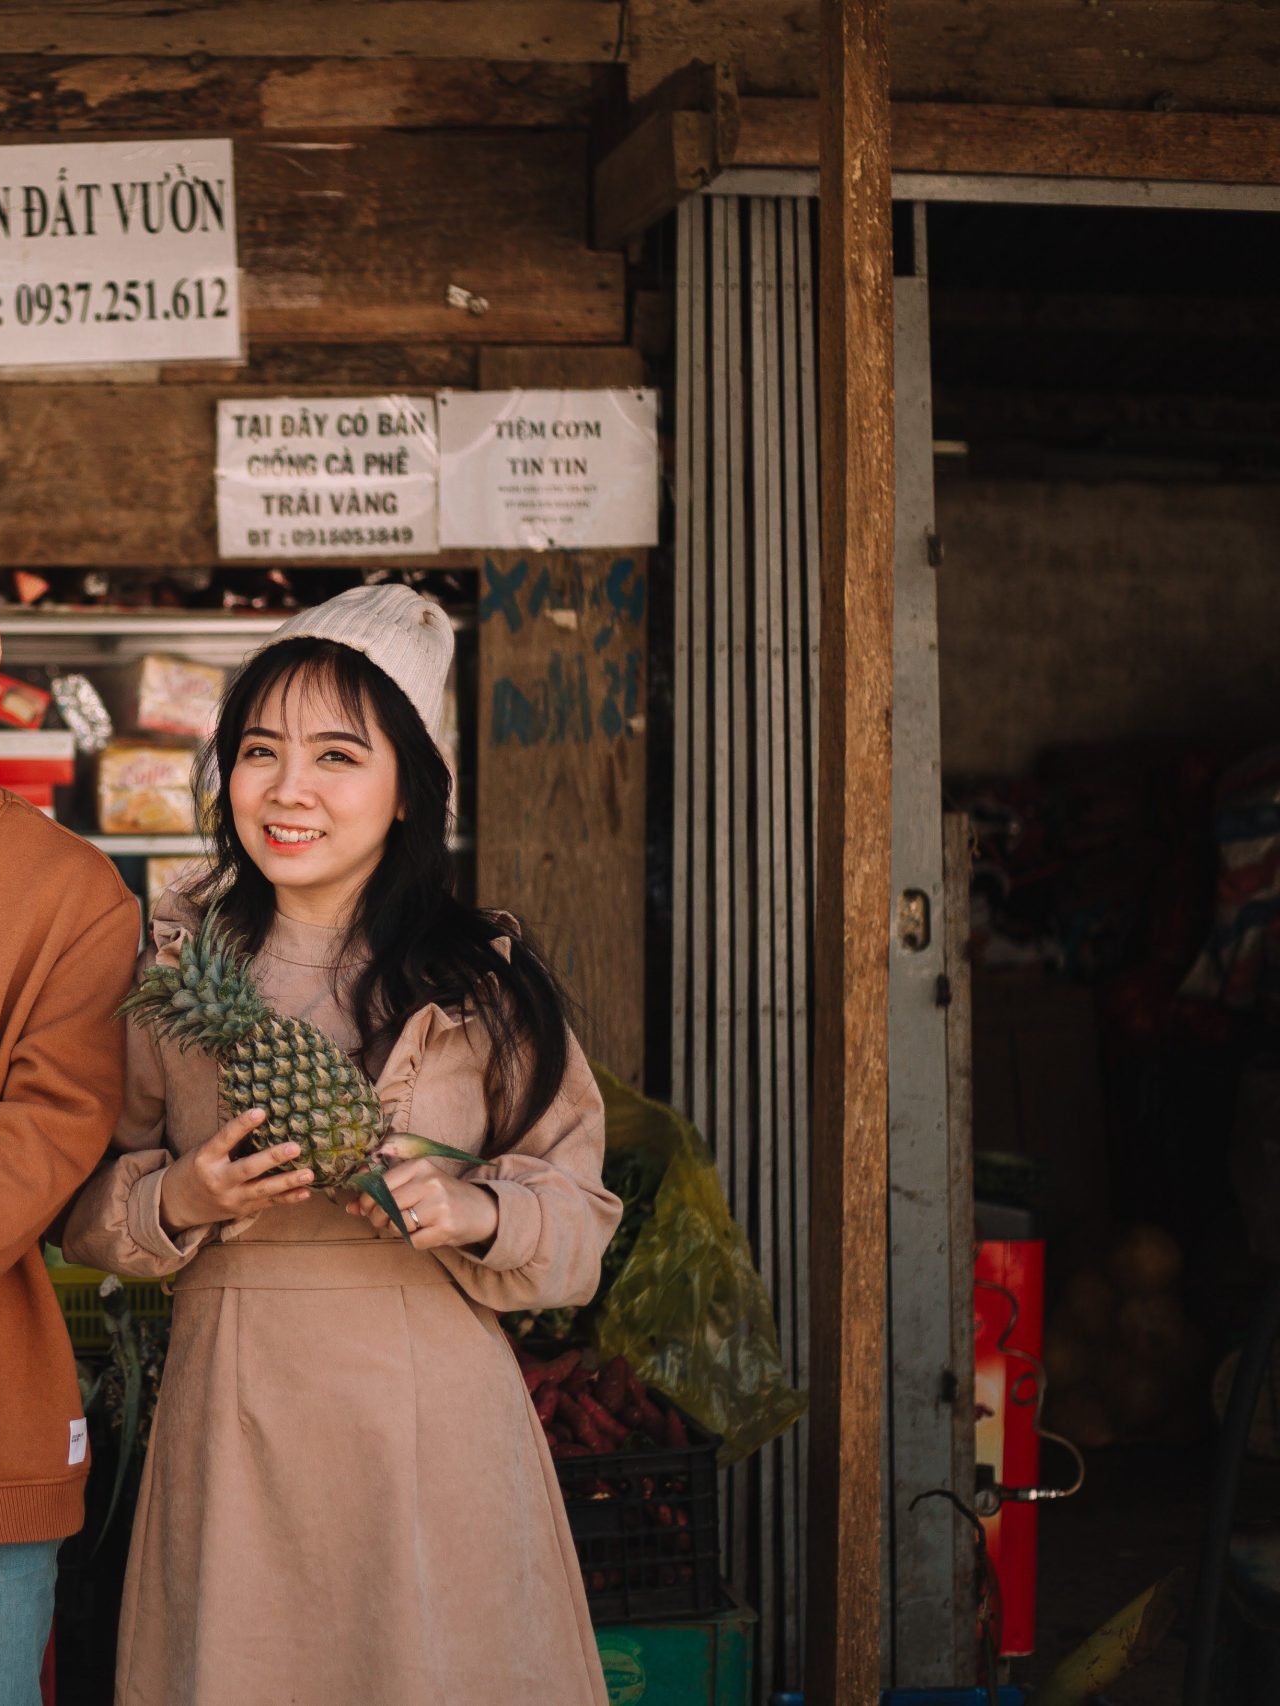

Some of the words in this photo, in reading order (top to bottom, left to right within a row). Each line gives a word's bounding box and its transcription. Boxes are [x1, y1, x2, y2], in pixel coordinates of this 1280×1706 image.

[22, 166, 101, 238] ĐẤT
[111, 163, 227, 235] VƯỜN
[15, 277, 230, 326] 0937.251.612
[232, 413, 272, 443] TẠI
[280, 407, 328, 438] ĐÂY
[336, 407, 368, 437] CÓ
[496, 418, 545, 442] TIỆM
[551, 419, 601, 438] CƠM
[247, 446, 317, 476] GIỐNG
[325, 448, 354, 475] CÀ
[363, 446, 409, 476] PHÊ
[509, 457, 543, 475] TIN
[550, 457, 587, 475] TIN
[262, 488, 320, 516] TRÁI
[329, 487, 398, 515] VÀNG
